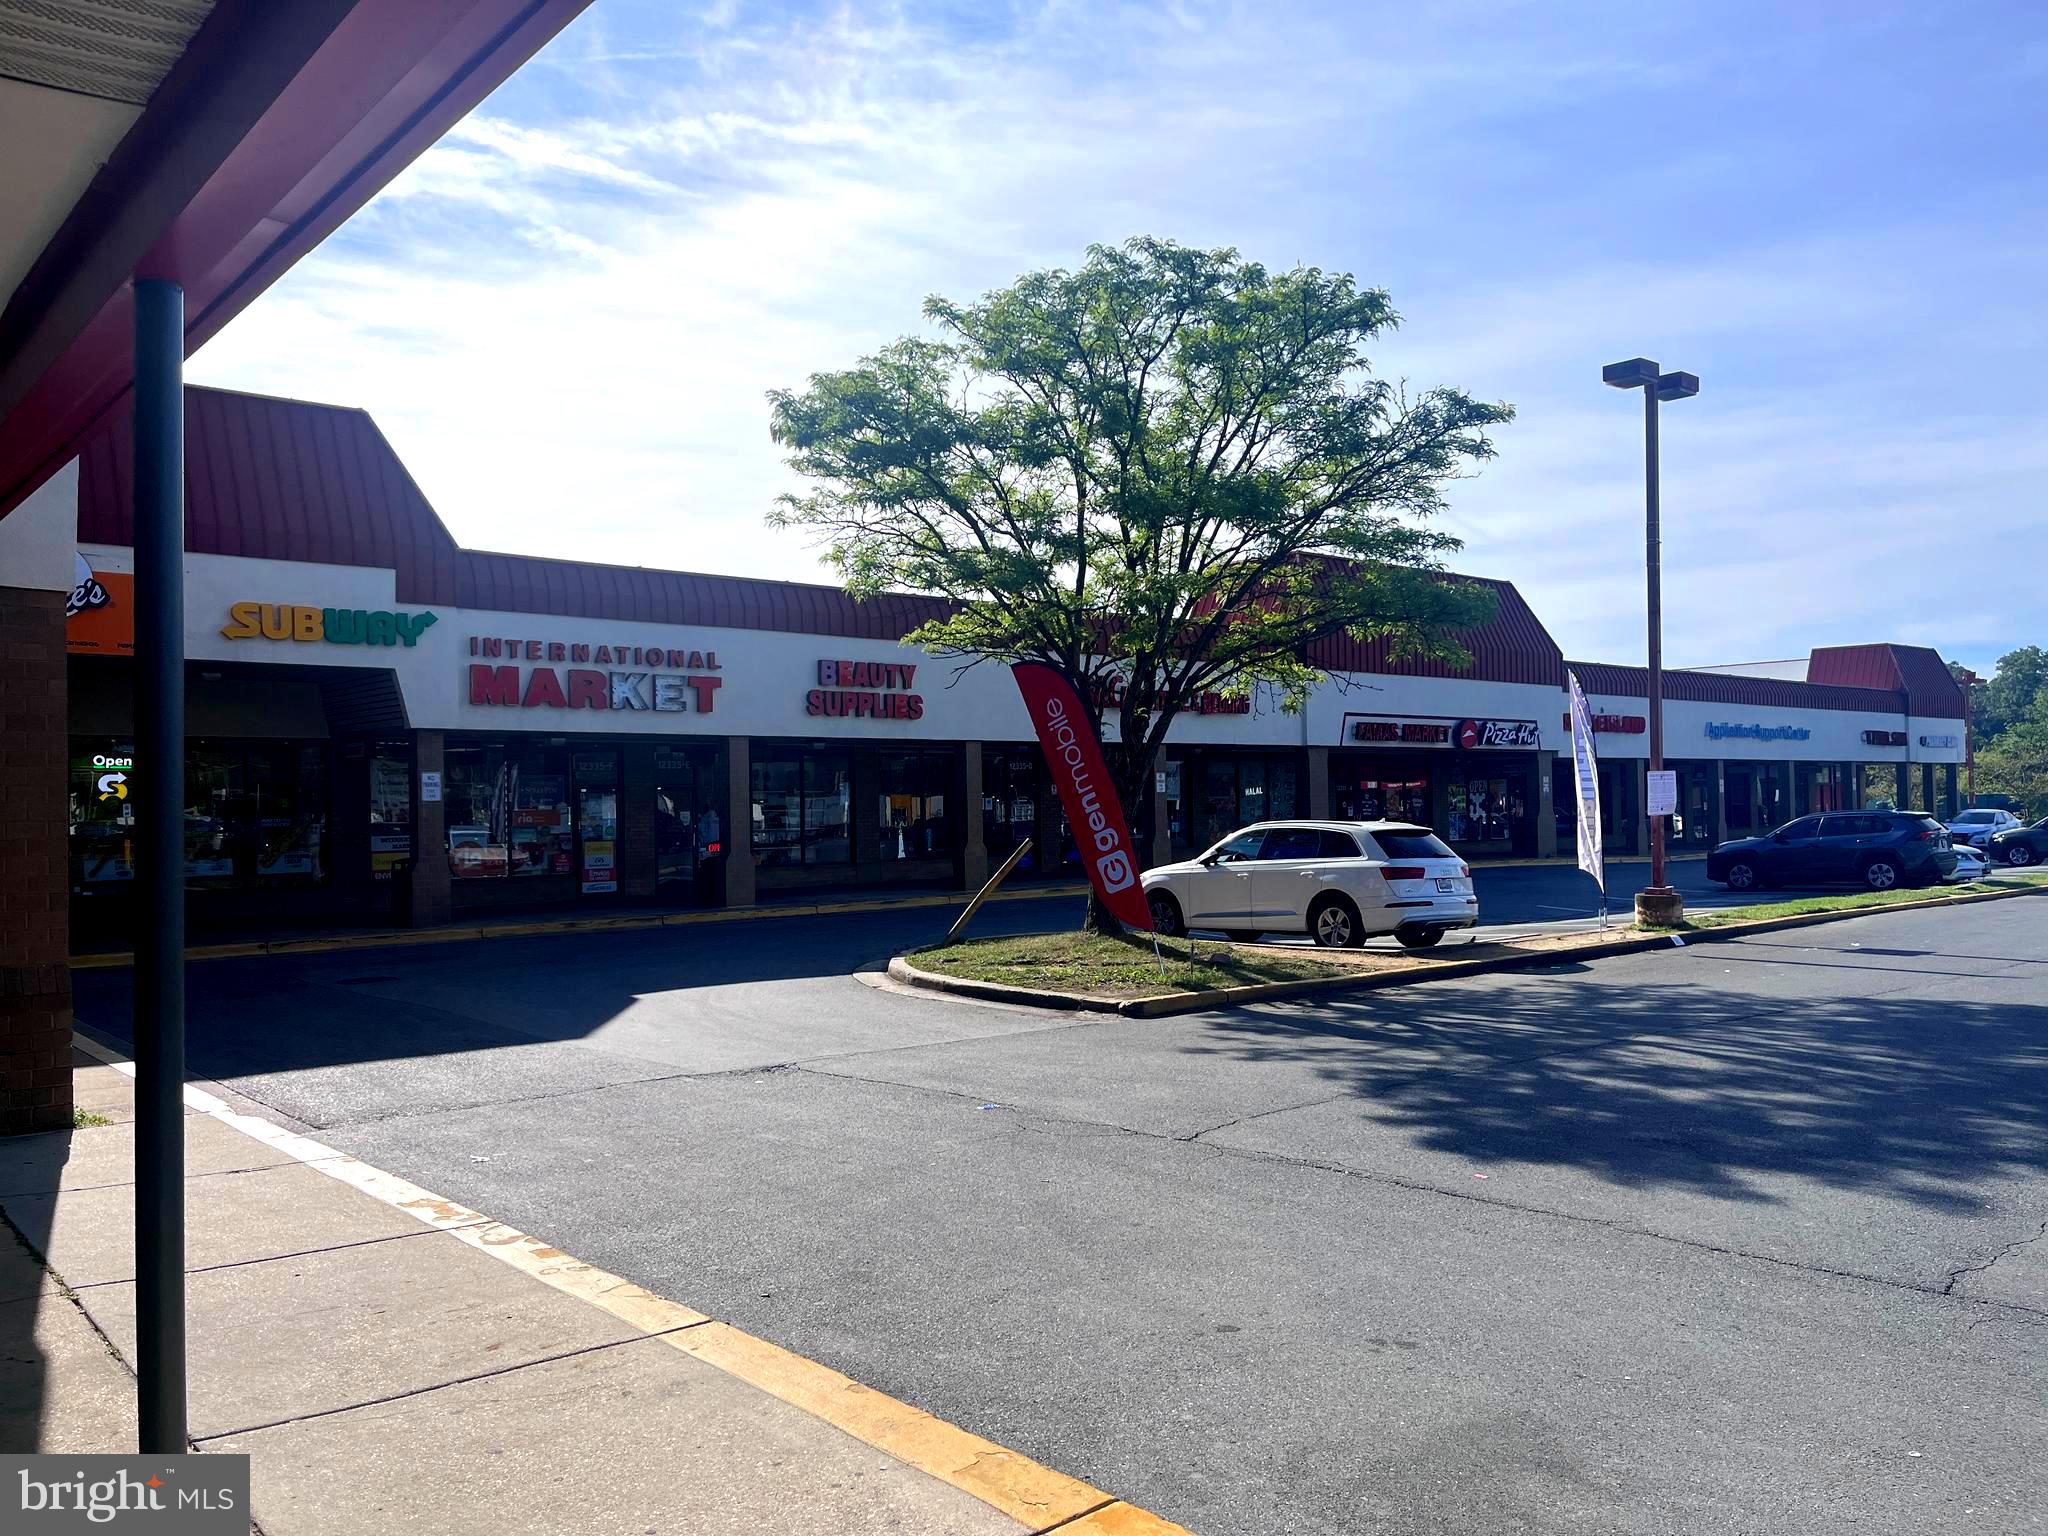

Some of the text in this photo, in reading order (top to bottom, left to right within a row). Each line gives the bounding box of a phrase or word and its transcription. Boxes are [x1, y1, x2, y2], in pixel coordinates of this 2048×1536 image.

[220, 602, 438, 647] SUBWAY
[470, 637, 722, 669] INTERNATIONAL
[469, 664, 722, 713] MARKET
[817, 660, 917, 689] BEAUTY
[806, 689, 923, 720] SUPPLIES
[1481, 722, 1543, 745] Pizza Hut
[92, 754, 133, 769] Open
